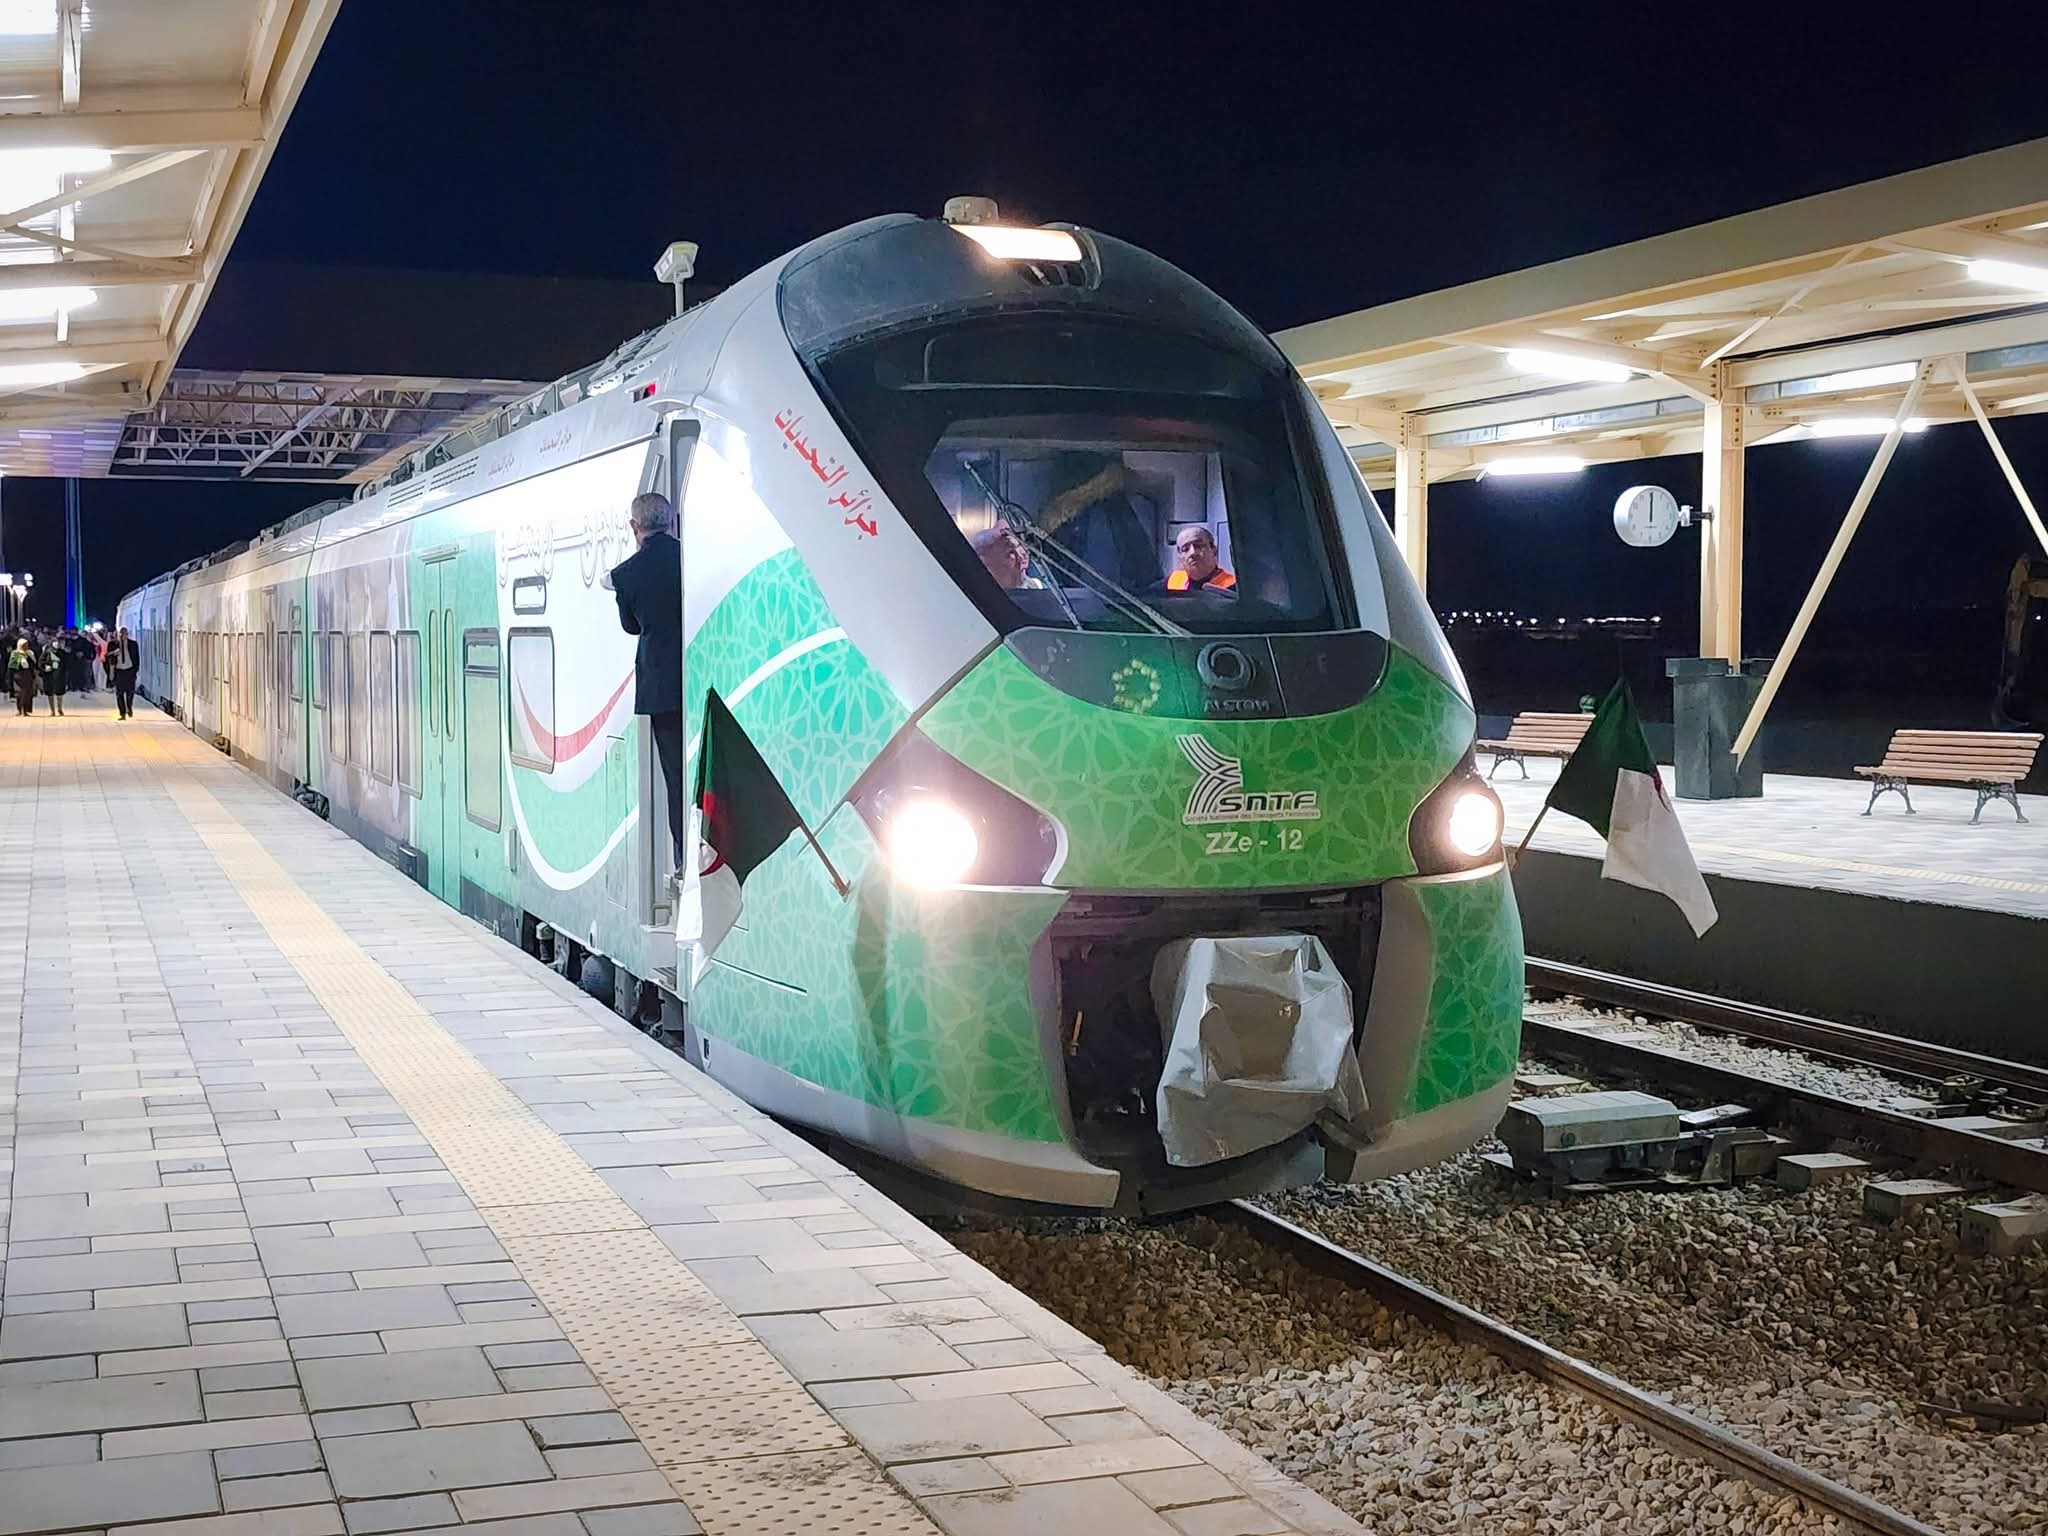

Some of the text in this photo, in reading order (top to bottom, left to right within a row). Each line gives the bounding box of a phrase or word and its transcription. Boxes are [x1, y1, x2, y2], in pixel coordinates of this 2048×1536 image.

[827, 489, 878, 541] جزائر
[1205, 831, 1253, 855] ZZe
[1276, 828, 1304, 852] 12
